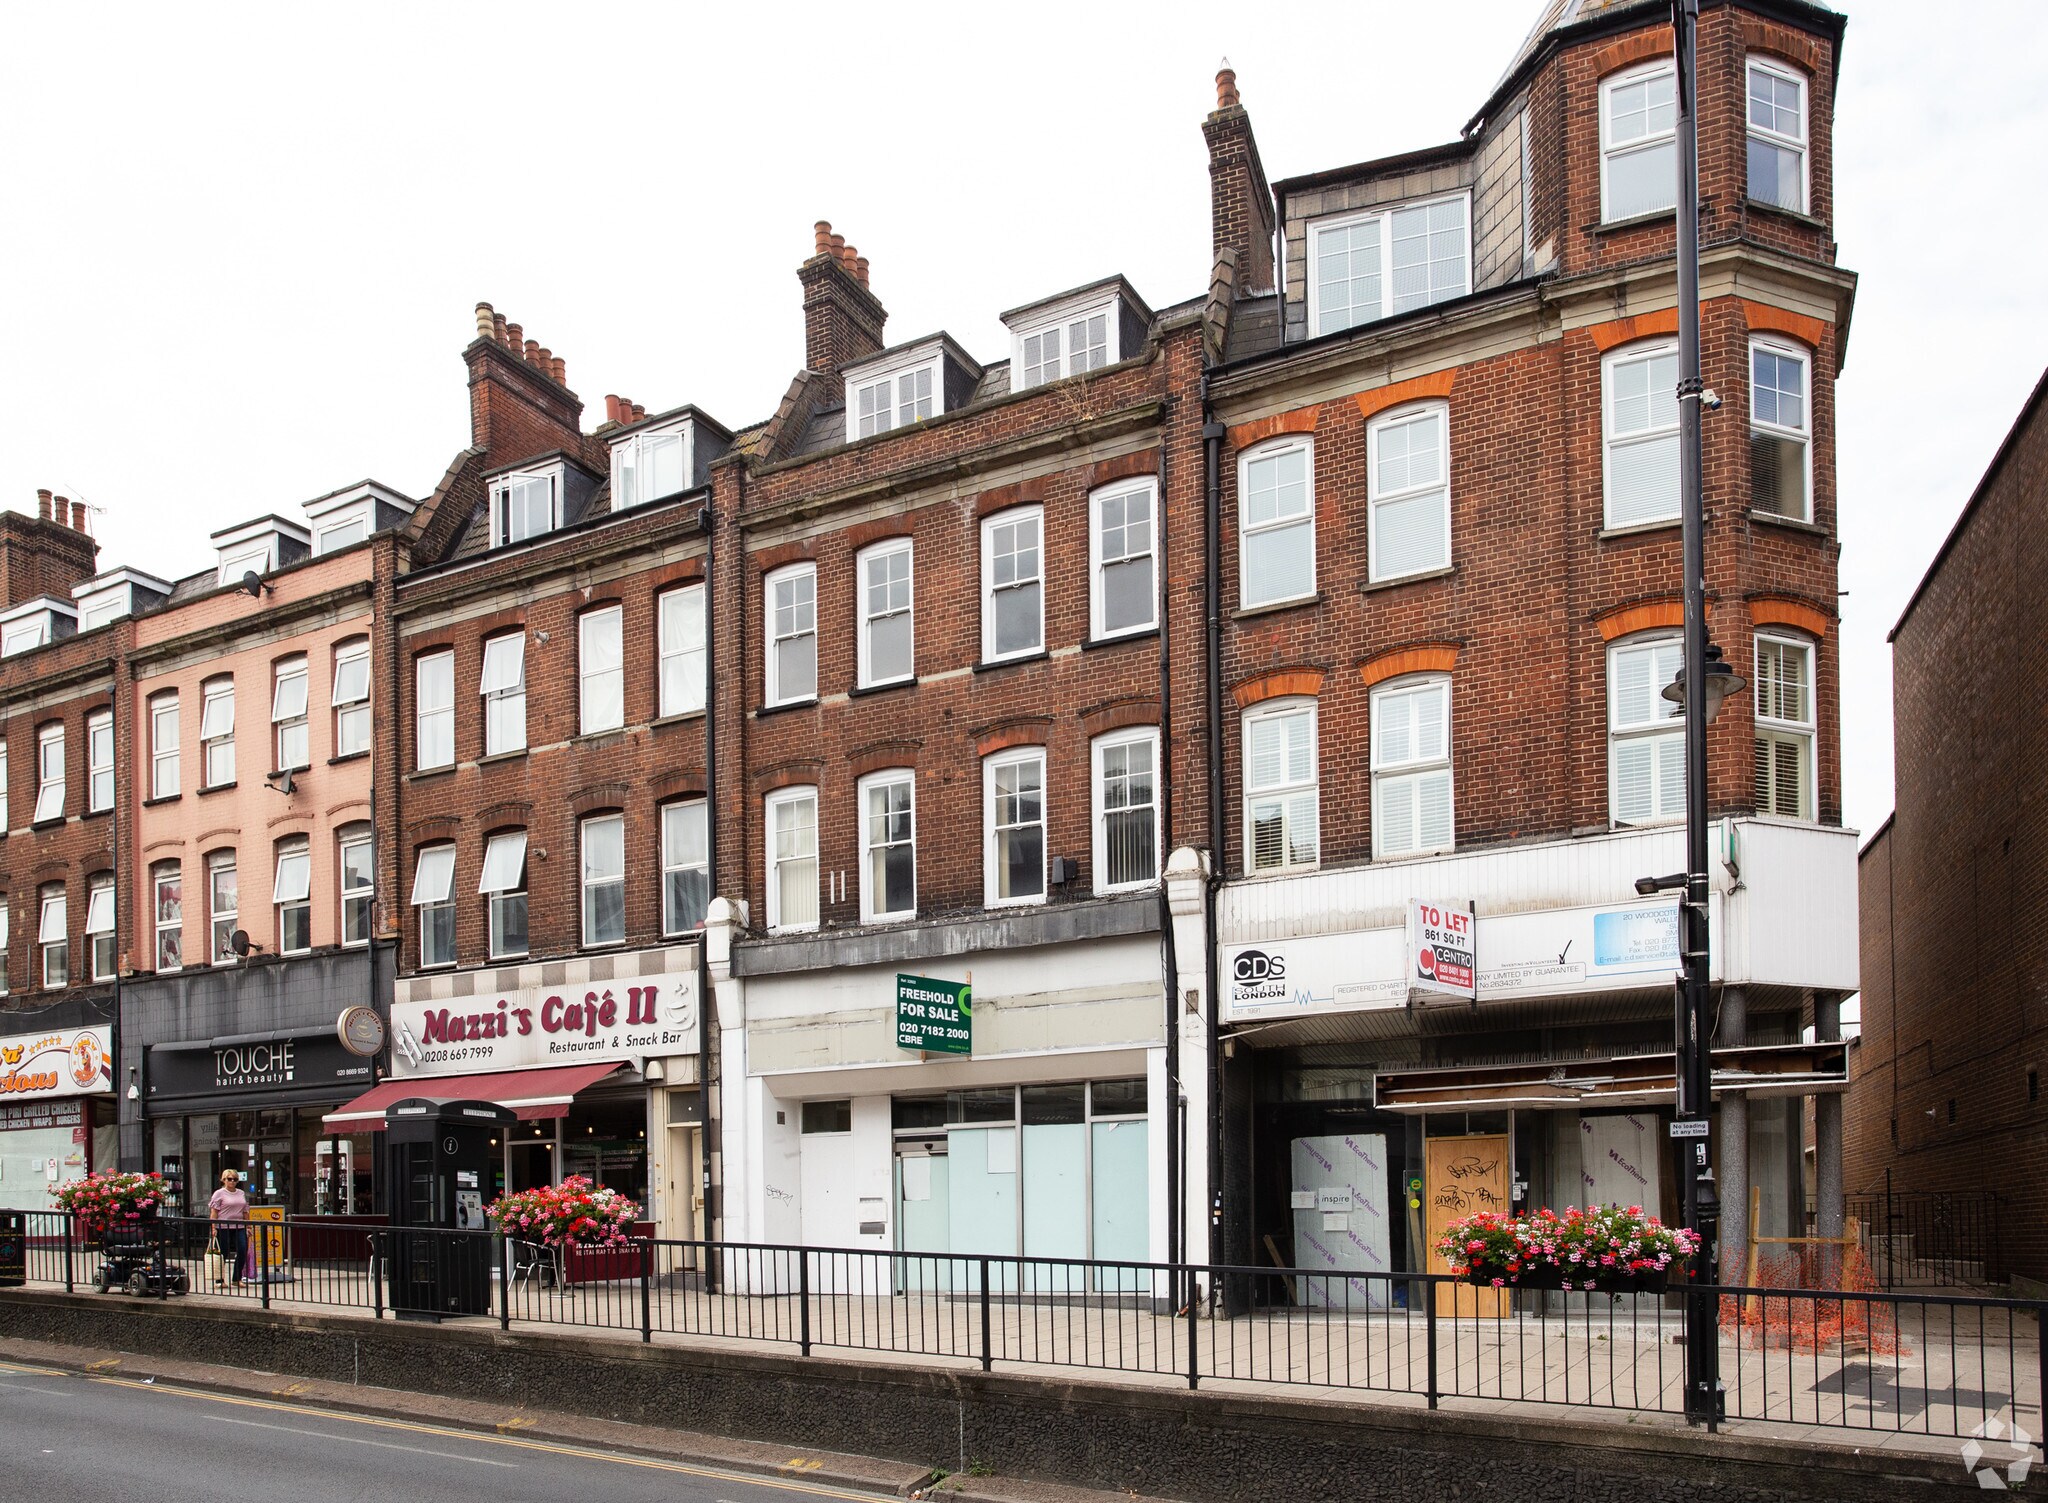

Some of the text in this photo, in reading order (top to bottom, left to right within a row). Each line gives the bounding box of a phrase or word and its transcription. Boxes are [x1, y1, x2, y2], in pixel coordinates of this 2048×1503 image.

[1420, 905, 1468, 934] TO LET
[1623, 908, 1678, 921] 20 WOODCOTE
[1425, 929, 1465, 947] 861 SQ FT
[1234, 956, 1285, 979] CDS
[1234, 984, 1285, 995] SOUTH
[1337, 984, 1378, 995] REGISTERED
[1379, 981, 1407, 990] CHARITY
[1493, 971, 1521, 980] LIMITED
[900, 987, 954, 1005] FREEHOLD
[1234, 990, 1285, 1001] LONDON
[1391, 988, 1433, 997] REGITERED
[421, 986, 659, 1044] Mazzi's Café II
[900, 1002, 959, 1022] FOR SALE
[898, 1034, 923, 1045] CBRE
[900, 1022, 969, 1040] 020 7182 2000
[549, 1031, 681, 1054] Restaurant & Snack Bar
[214, 1038, 294, 1076] TOUCHÉ
[425, 1046, 493, 1063] 0208 669 7999
[247, 1073, 283, 1084] beauty
[8, 1107, 22, 1119] PIRI
[23, 1105, 50, 1118] GRILLED
[51, 1102, 81, 1116] CHICKEN
[8, 1119, 30, 1129] CHICKEN
[32, 1116, 53, 1127] WRAPS
[56, 1114, 81, 1125] BURGERS
[1300, 1138, 1325, 1165] EcoTherm
[1352, 1144, 1378, 1171] EcoTherm
[1617, 1158, 1648, 1186] EcoTherm
[1321, 1195, 1350, 1204] inspire
[1355, 1238, 1382, 1265] EcoTherm
